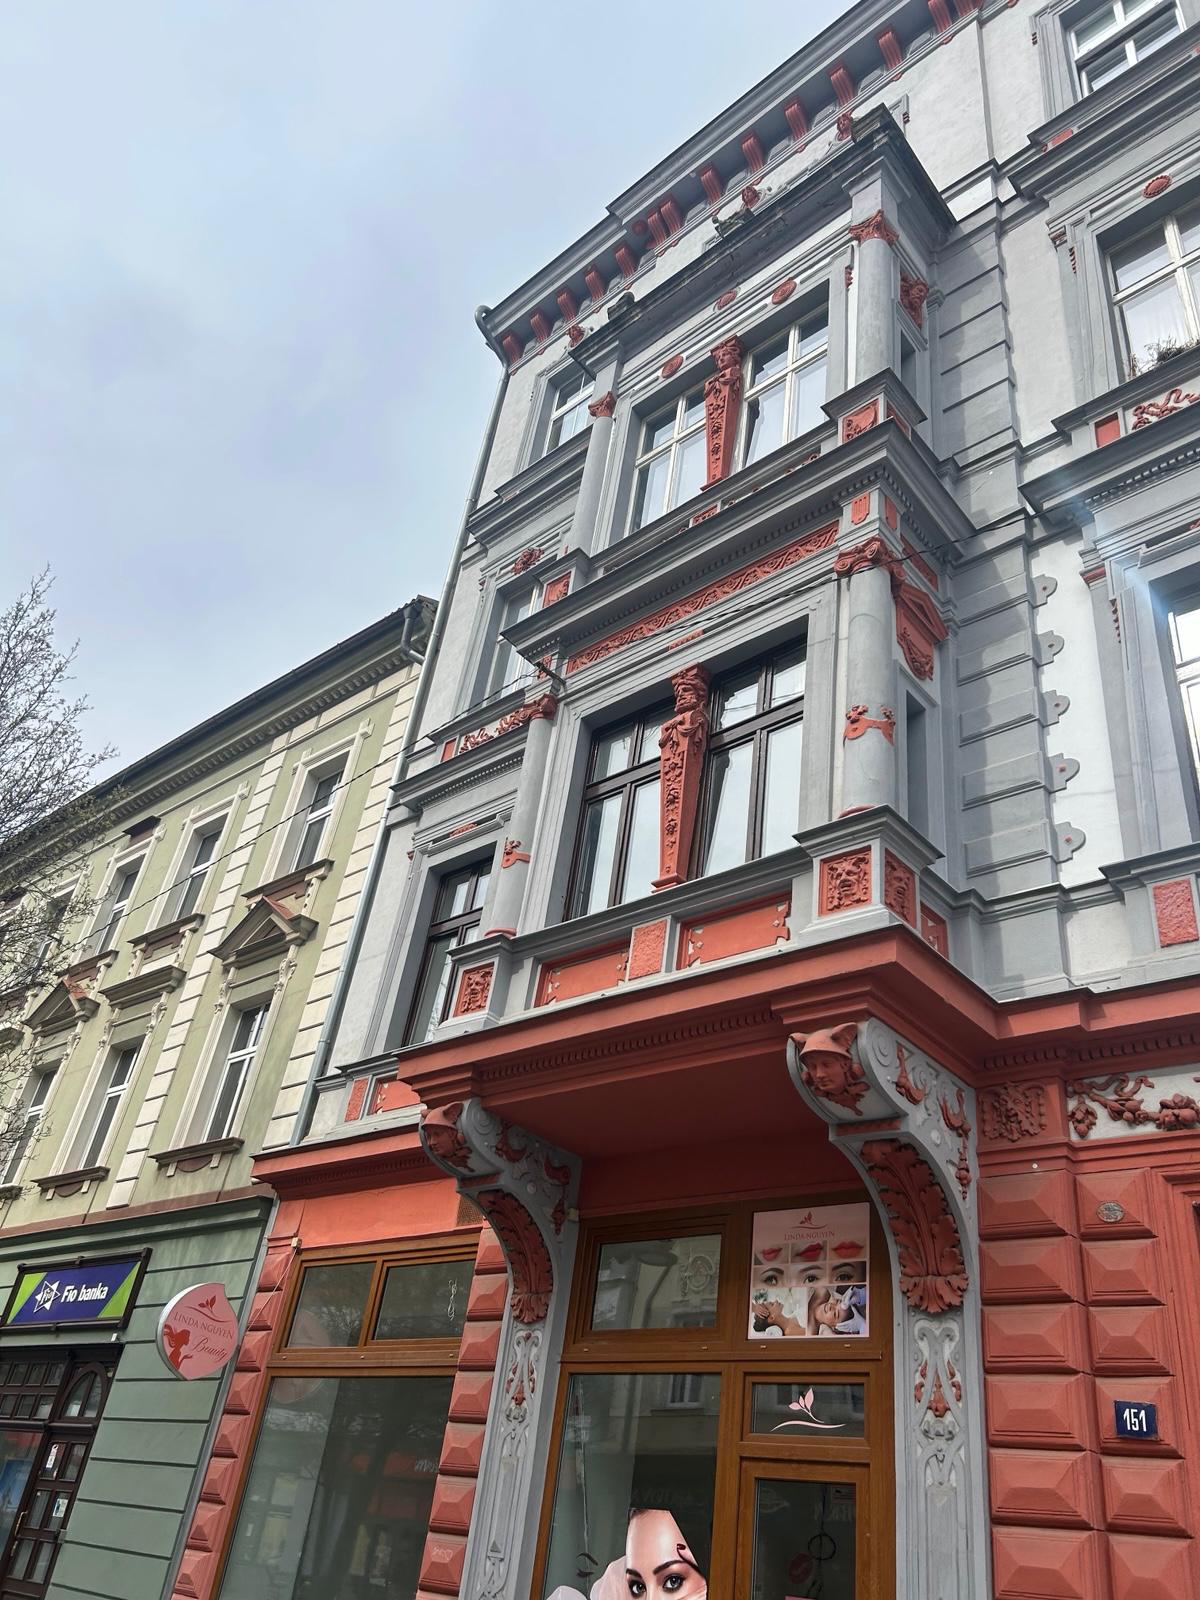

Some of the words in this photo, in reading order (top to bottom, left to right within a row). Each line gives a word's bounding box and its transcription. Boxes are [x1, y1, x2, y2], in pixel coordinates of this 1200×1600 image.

[784, 1232, 805, 1241] LINDA
[61, 1285, 78, 1303] Fio
[78, 1282, 109, 1302] banka
[173, 1311, 199, 1329] LINDA
[201, 1322, 233, 1340] NGUYEN
[192, 1336, 228, 1364] Beauty
[1123, 1408, 1147, 1432] 151
